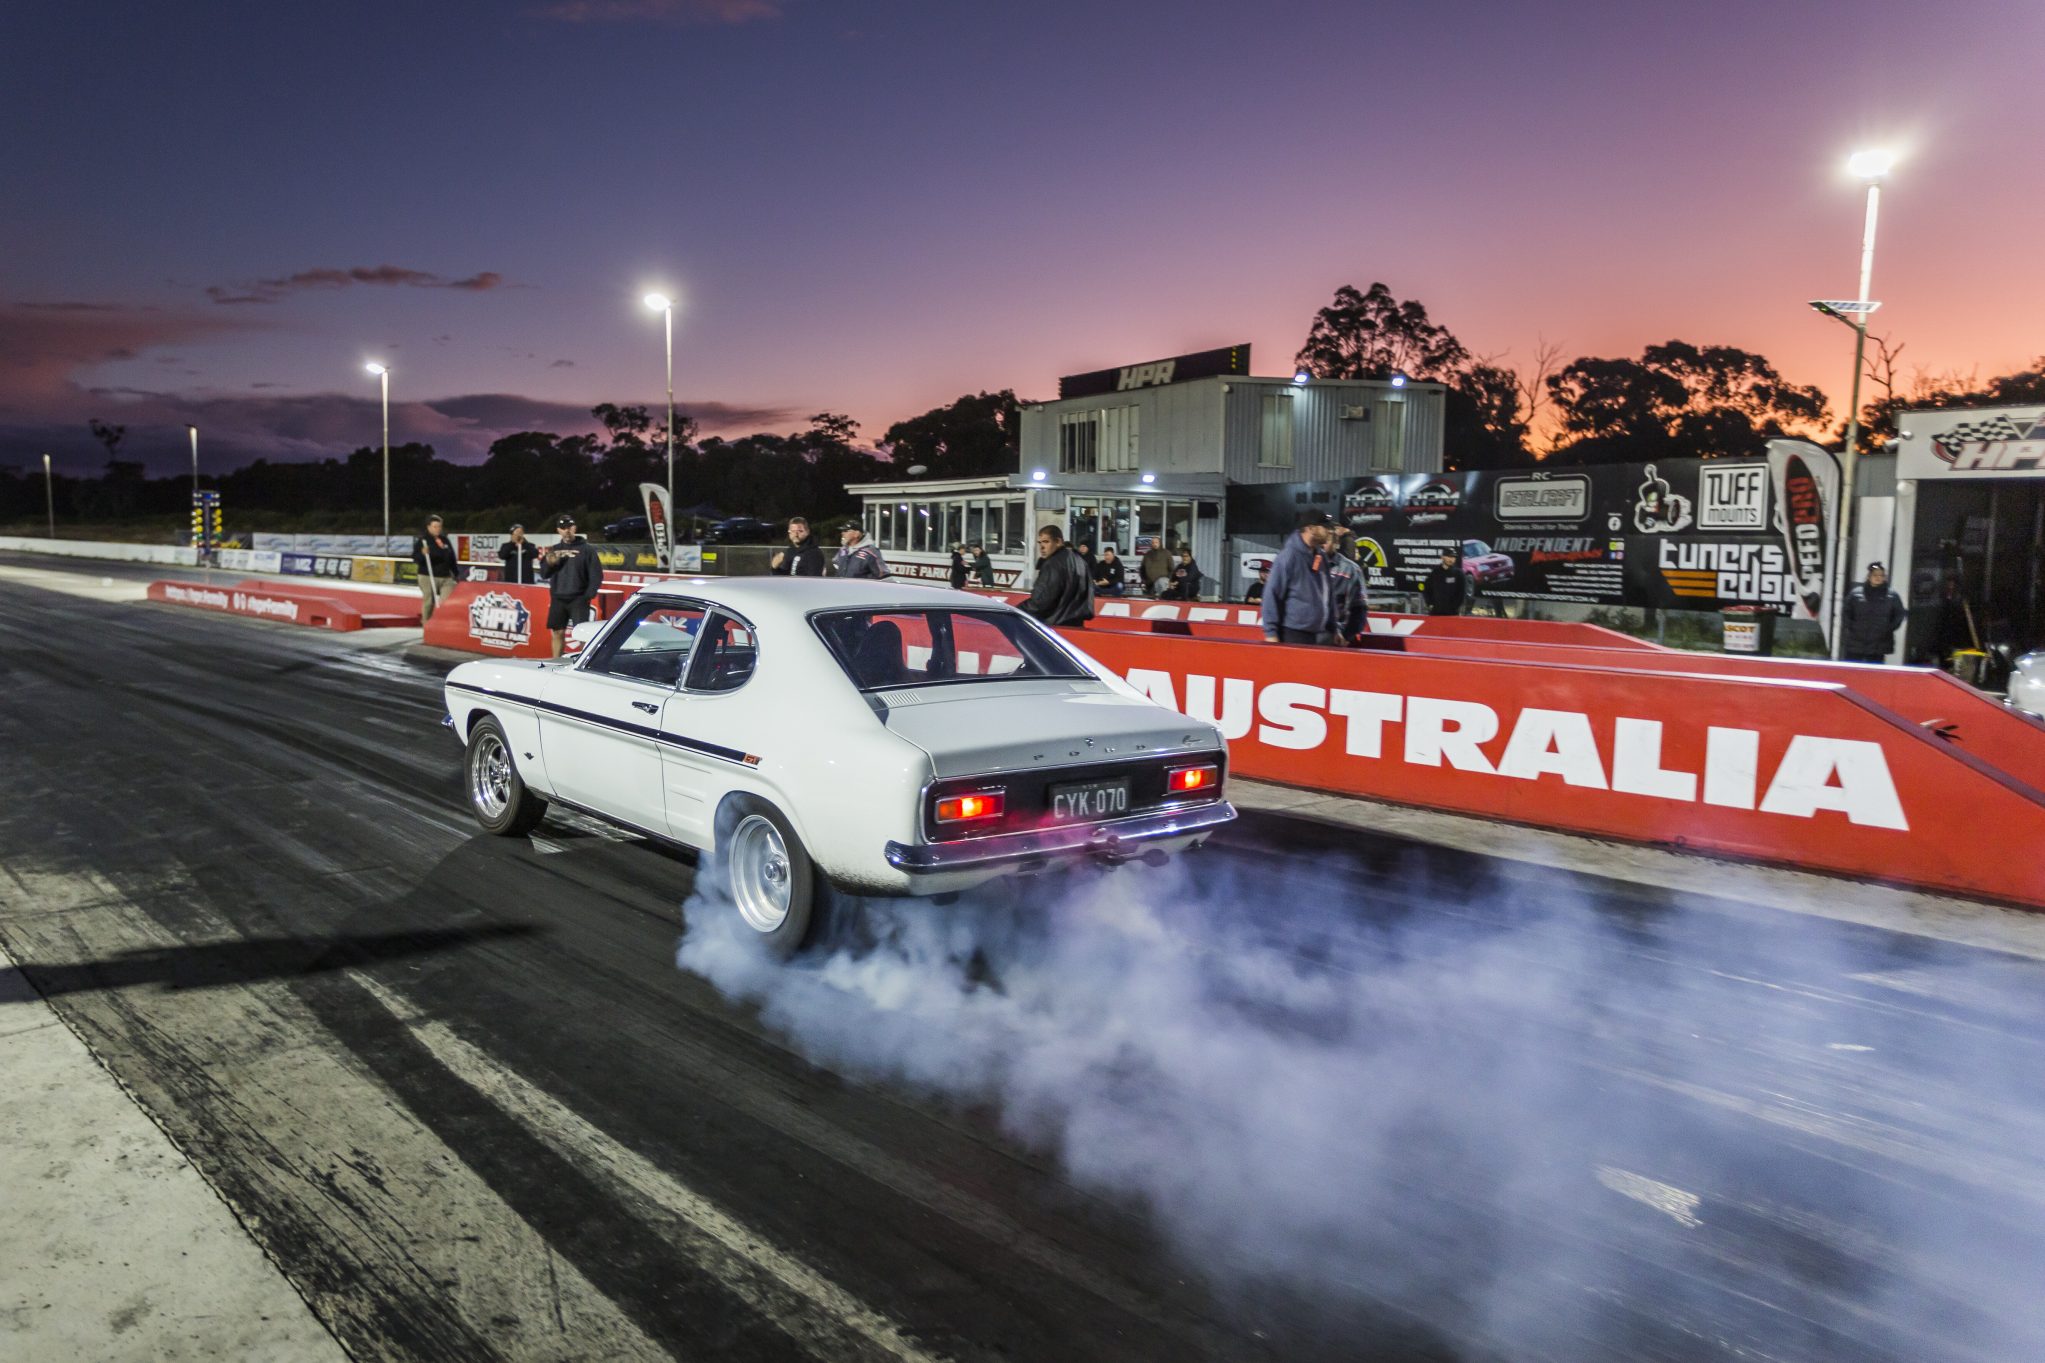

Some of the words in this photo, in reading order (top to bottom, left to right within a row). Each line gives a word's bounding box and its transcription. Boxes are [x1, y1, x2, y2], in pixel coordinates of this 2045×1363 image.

[1117, 359, 1176, 391] HPR
[1949, 441, 2045, 471] HP
[1531, 472, 1551, 480] RC
[1707, 472, 1760, 506] TUFF
[1345, 494, 1392, 507] RPM
[1406, 492, 1460, 506] RPM
[1493, 537, 1595, 553] INDEPENDENT
[480, 606, 519, 632] HPR
[1126, 667, 1910, 832] AUSTRALIA
